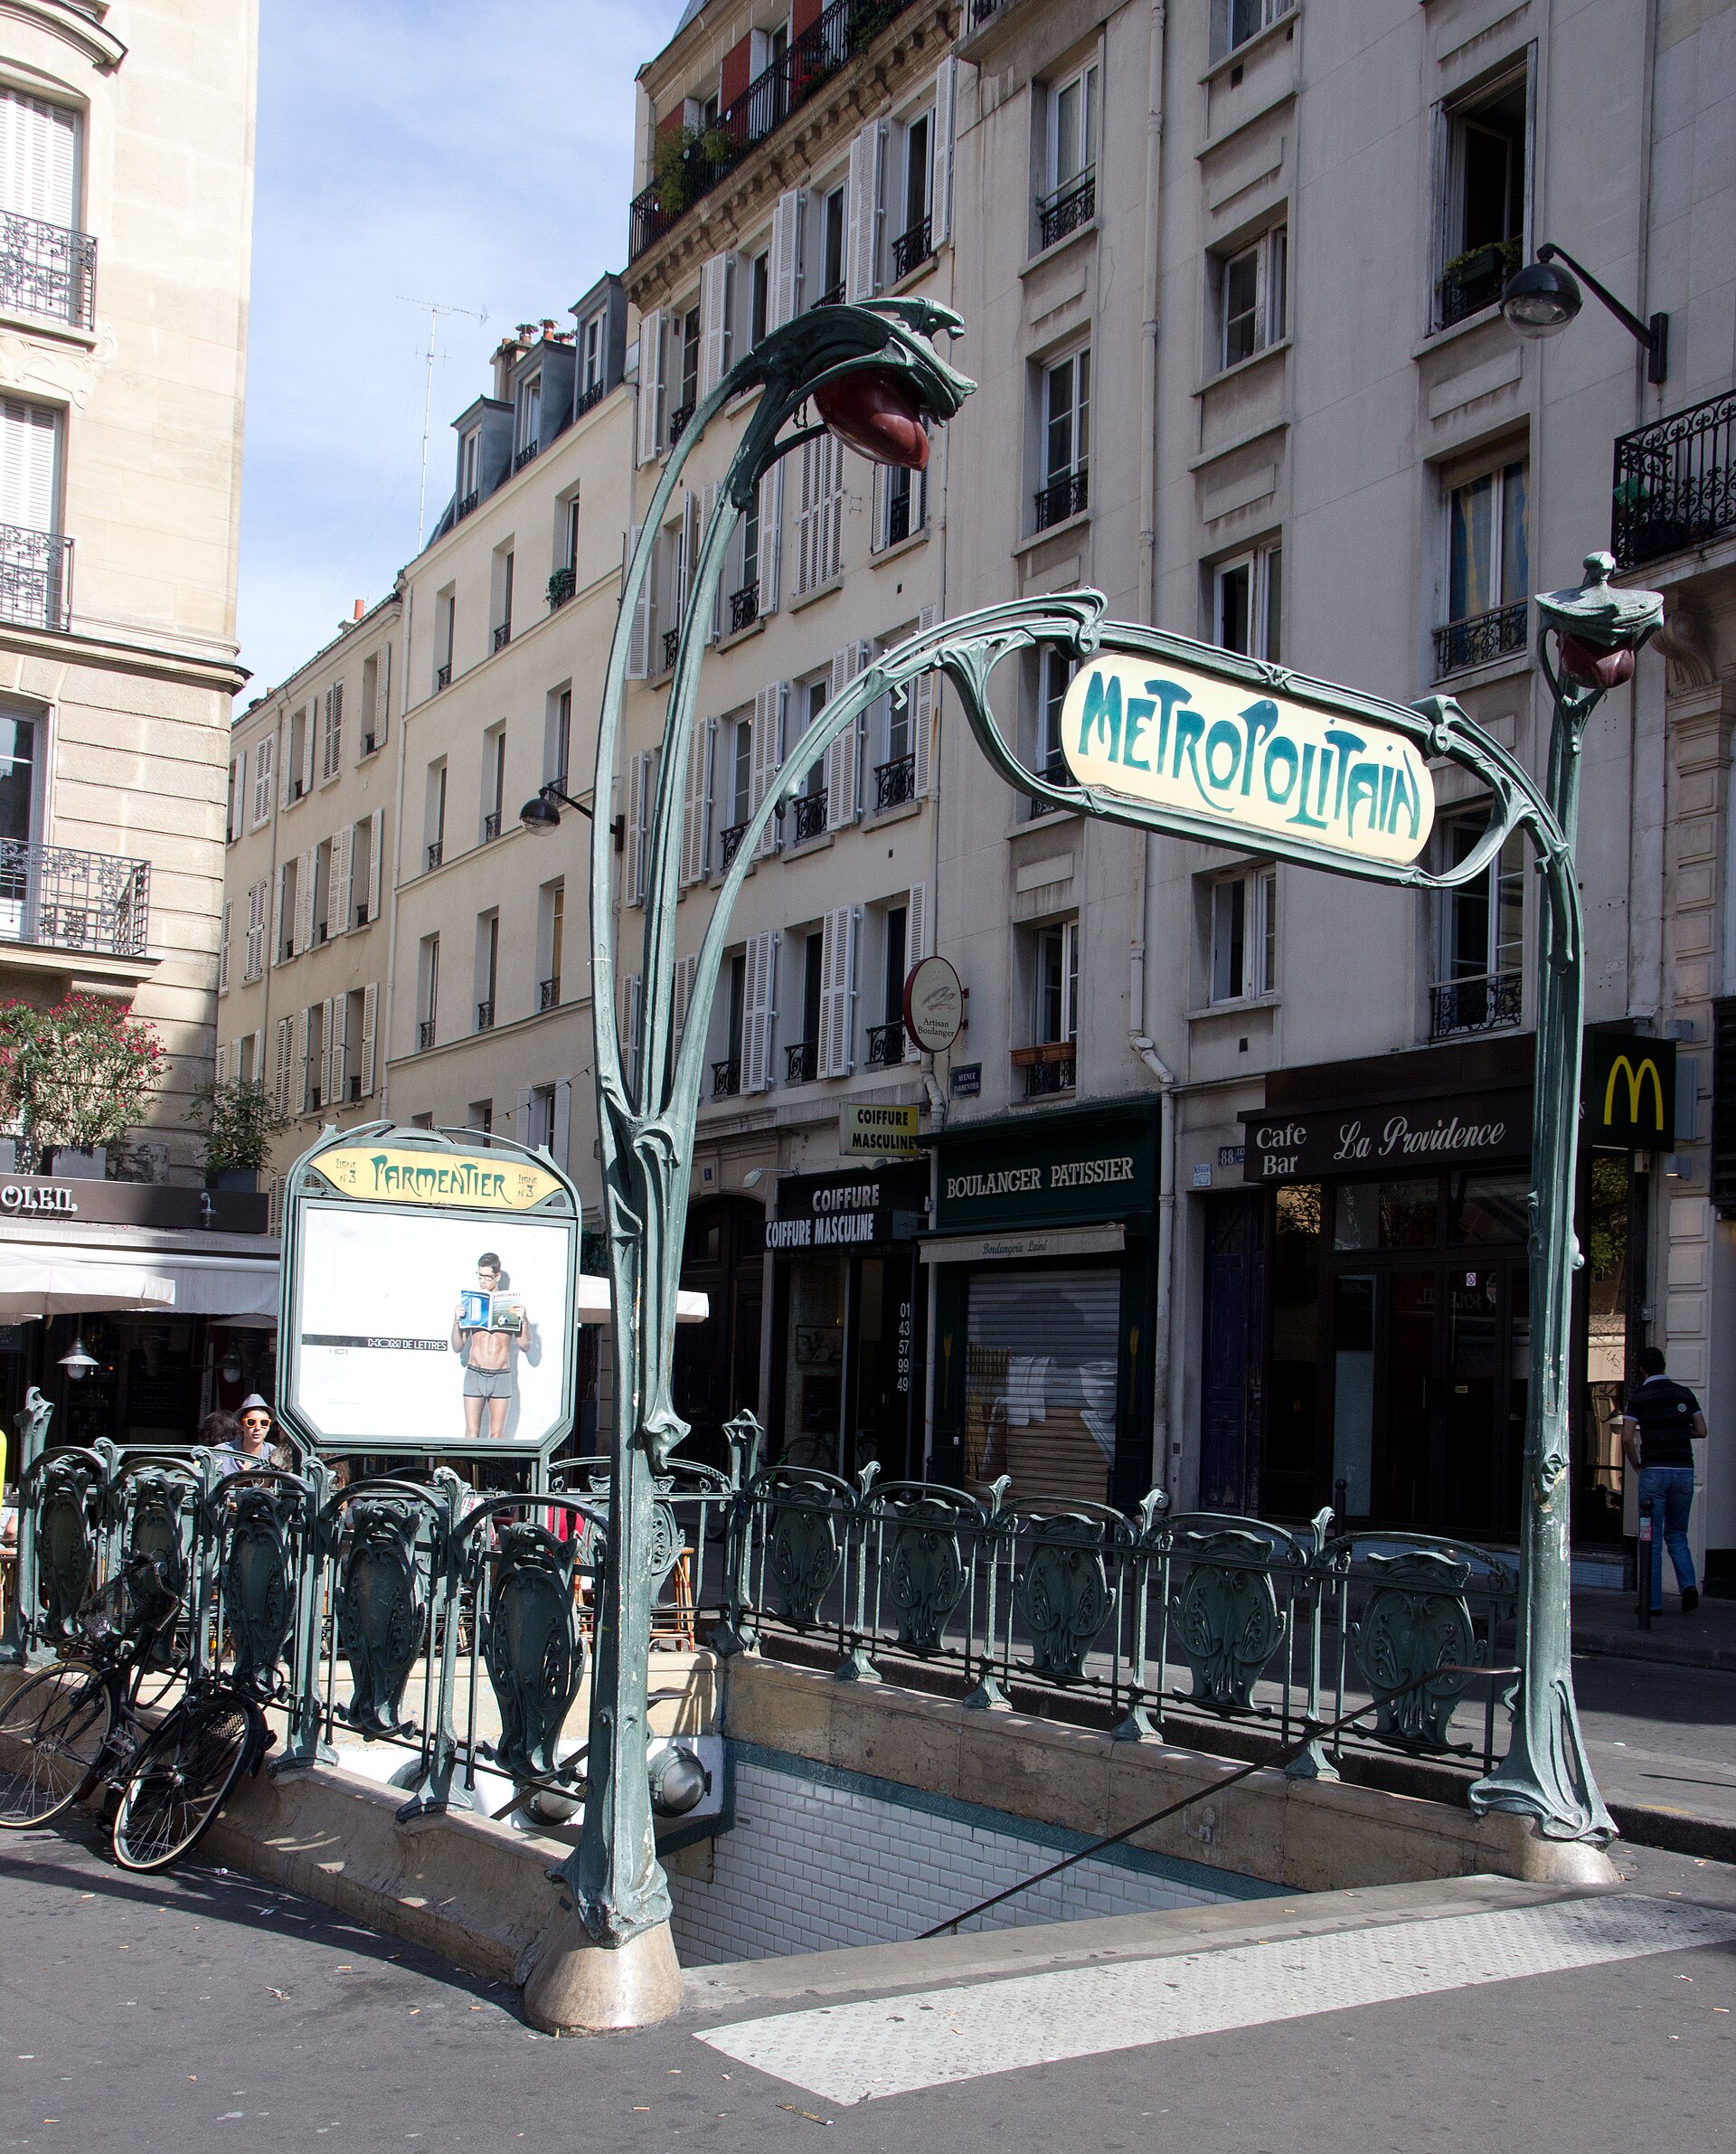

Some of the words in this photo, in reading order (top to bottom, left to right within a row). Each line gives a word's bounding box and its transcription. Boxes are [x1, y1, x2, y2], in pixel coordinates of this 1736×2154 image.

[1078, 671, 1420, 840] METROPOLITAIN
[923, 1017, 949, 1028] Artisan
[918, 1026, 955, 1038] Boulanger
[858, 1110, 908, 1126] COIFFURE
[853, 1133, 913, 1149] MASCULINE
[1256, 1122, 1307, 1148] Cafe
[1333, 1121, 1371, 1160] La
[1378, 1116, 1505, 1156] Providence
[335, 1158, 356, 1168] LIGNE
[1221, 1149, 1234, 1165] 88
[1262, 1154, 1298, 1176] Bar
[348, 1169, 356, 1184] 3
[370, 1155, 512, 1204] PARMENTIER
[518, 1174, 538, 1185] LIGNE
[947, 1167, 1043, 1199] BOULANGER
[1050, 1157, 1135, 1188] PATISSIER
[526, 1185, 533, 1197] 3
[812, 1184, 880, 1213] COIFFURE
[766, 1219, 811, 1248] COIFFURE
[814, 1214, 874, 1244] MASCULINE
[983, 1242, 1024, 1256] Boulangerie
[1028, 1240, 1048, 1252] Lainé
[900, 1302, 910, 1318] 01
[899, 1320, 910, 1336] 43
[368, 1337, 401, 1348] HOM
[402, 1339, 413, 1349] DE
[414, 1339, 447, 1351] LETTRES
[899, 1339, 910, 1355] 57
[898, 1358, 909, 1373] 99
[897, 1376, 909, 1392] 49
